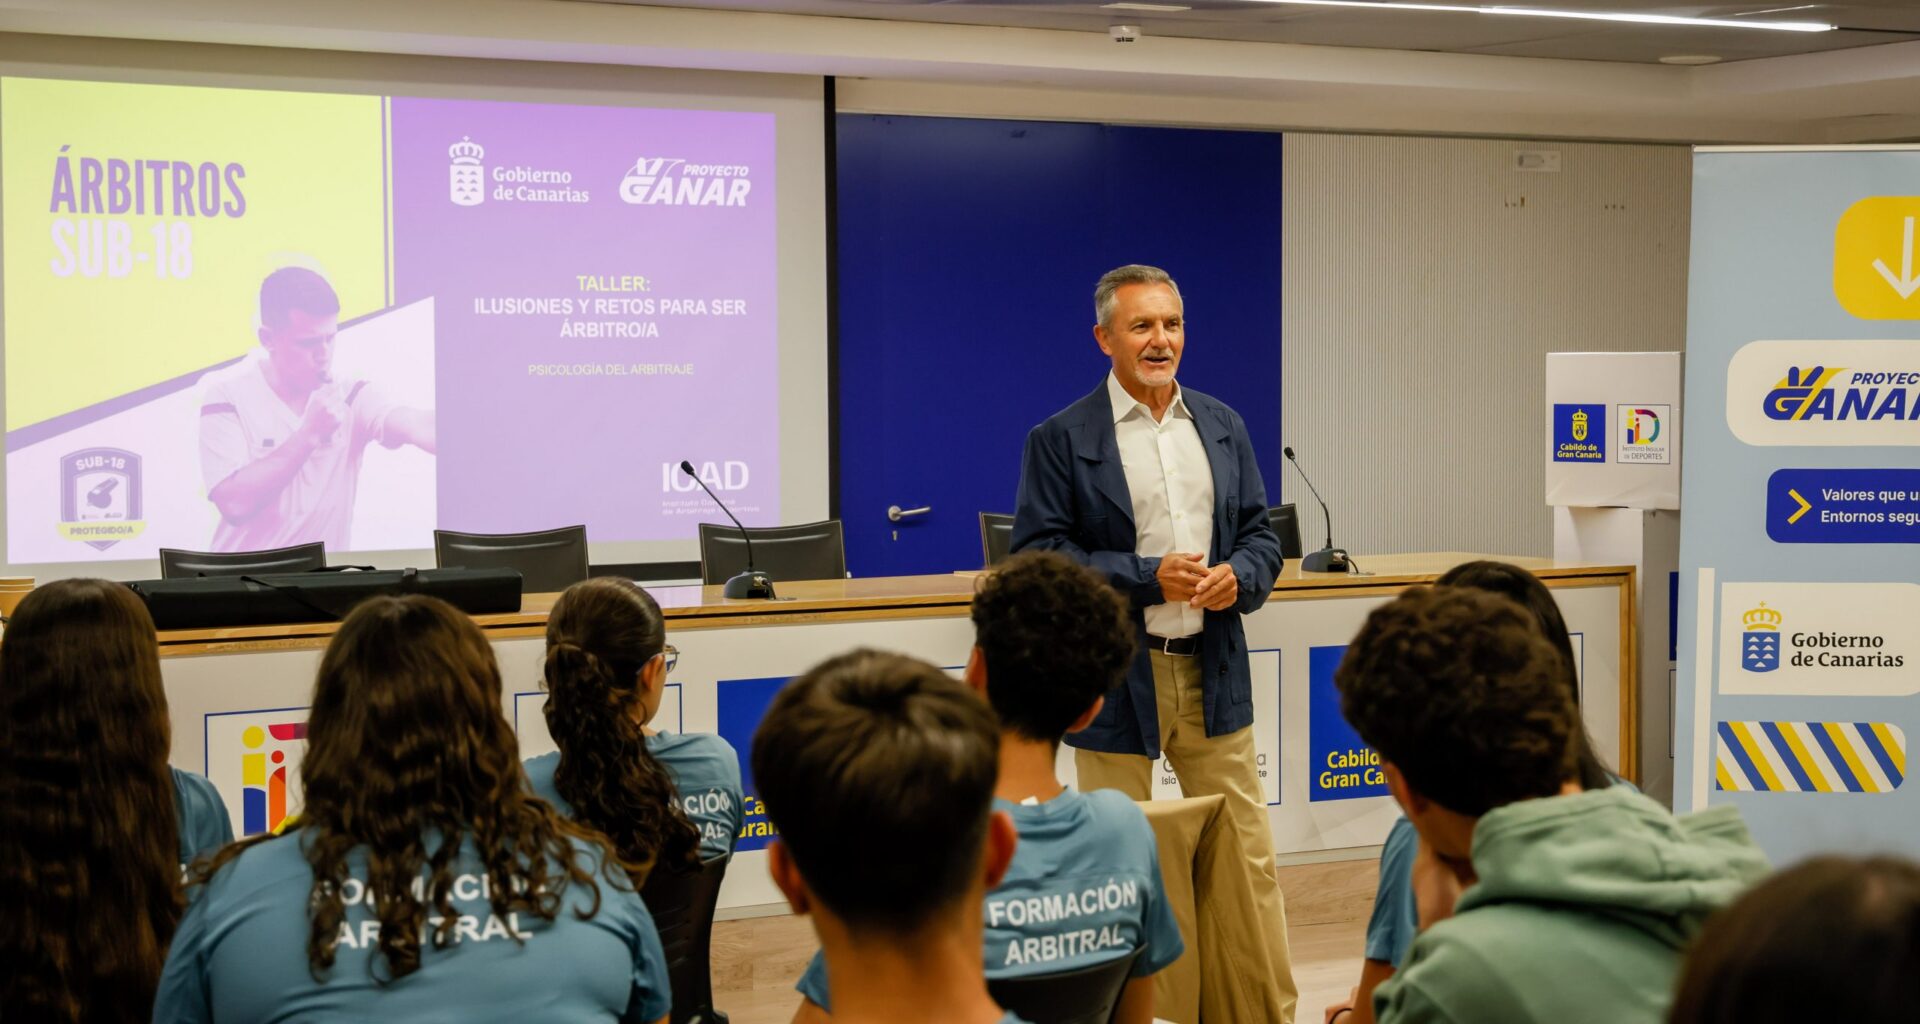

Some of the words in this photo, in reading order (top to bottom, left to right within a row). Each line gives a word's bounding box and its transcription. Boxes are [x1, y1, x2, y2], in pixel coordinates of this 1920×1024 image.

[492, 166, 572, 184] Gobierno
[683, 164, 749, 177] PROYECTO
[50, 145, 246, 218] ÁRBITROS
[493, 186, 514, 201] de
[516, 187, 589, 203] Canarias
[619, 175, 751, 206] GANAR
[50, 218, 193, 279] SUB-18
[577, 275, 650, 291] TALLER:
[474, 298, 573, 315] ILUSIONES
[577, 299, 591, 314] Y
[594, 299, 655, 315] RETOS
[660, 300, 707, 315] PARA
[711, 300, 747, 315] SER
[559, 318, 659, 338] ÁRBITRO/A
[528, 362, 603, 376] PSICOLOGÍA
[605, 364, 628, 375] DEL
[630, 363, 694, 375] ARBITRAJE
[1560, 443, 1587, 451] Cabildo
[1588, 443, 1597, 451] de
[1575, 451, 1602, 459] Canaria
[76, 456, 126, 470] SUB-18
[662, 460, 749, 493] ICAD
[1822, 488, 1875, 501] Valores
[1878, 490, 1906, 504] que
[1821, 510, 1885, 523] Entornos
[1791, 632, 1884, 649] Gobierno
[1791, 651, 1814, 667] de
[1817, 652, 1904, 668] Canarias
[1327, 748, 1380, 769] Cabild
[1161, 775, 1177, 785] Isla
[1319, 771, 1360, 789] Gran
[988, 878, 1137, 927] FORMACIÓN
[331, 912, 533, 949] ARITRAL
[1004, 923, 1125, 966] ARBITRAL
